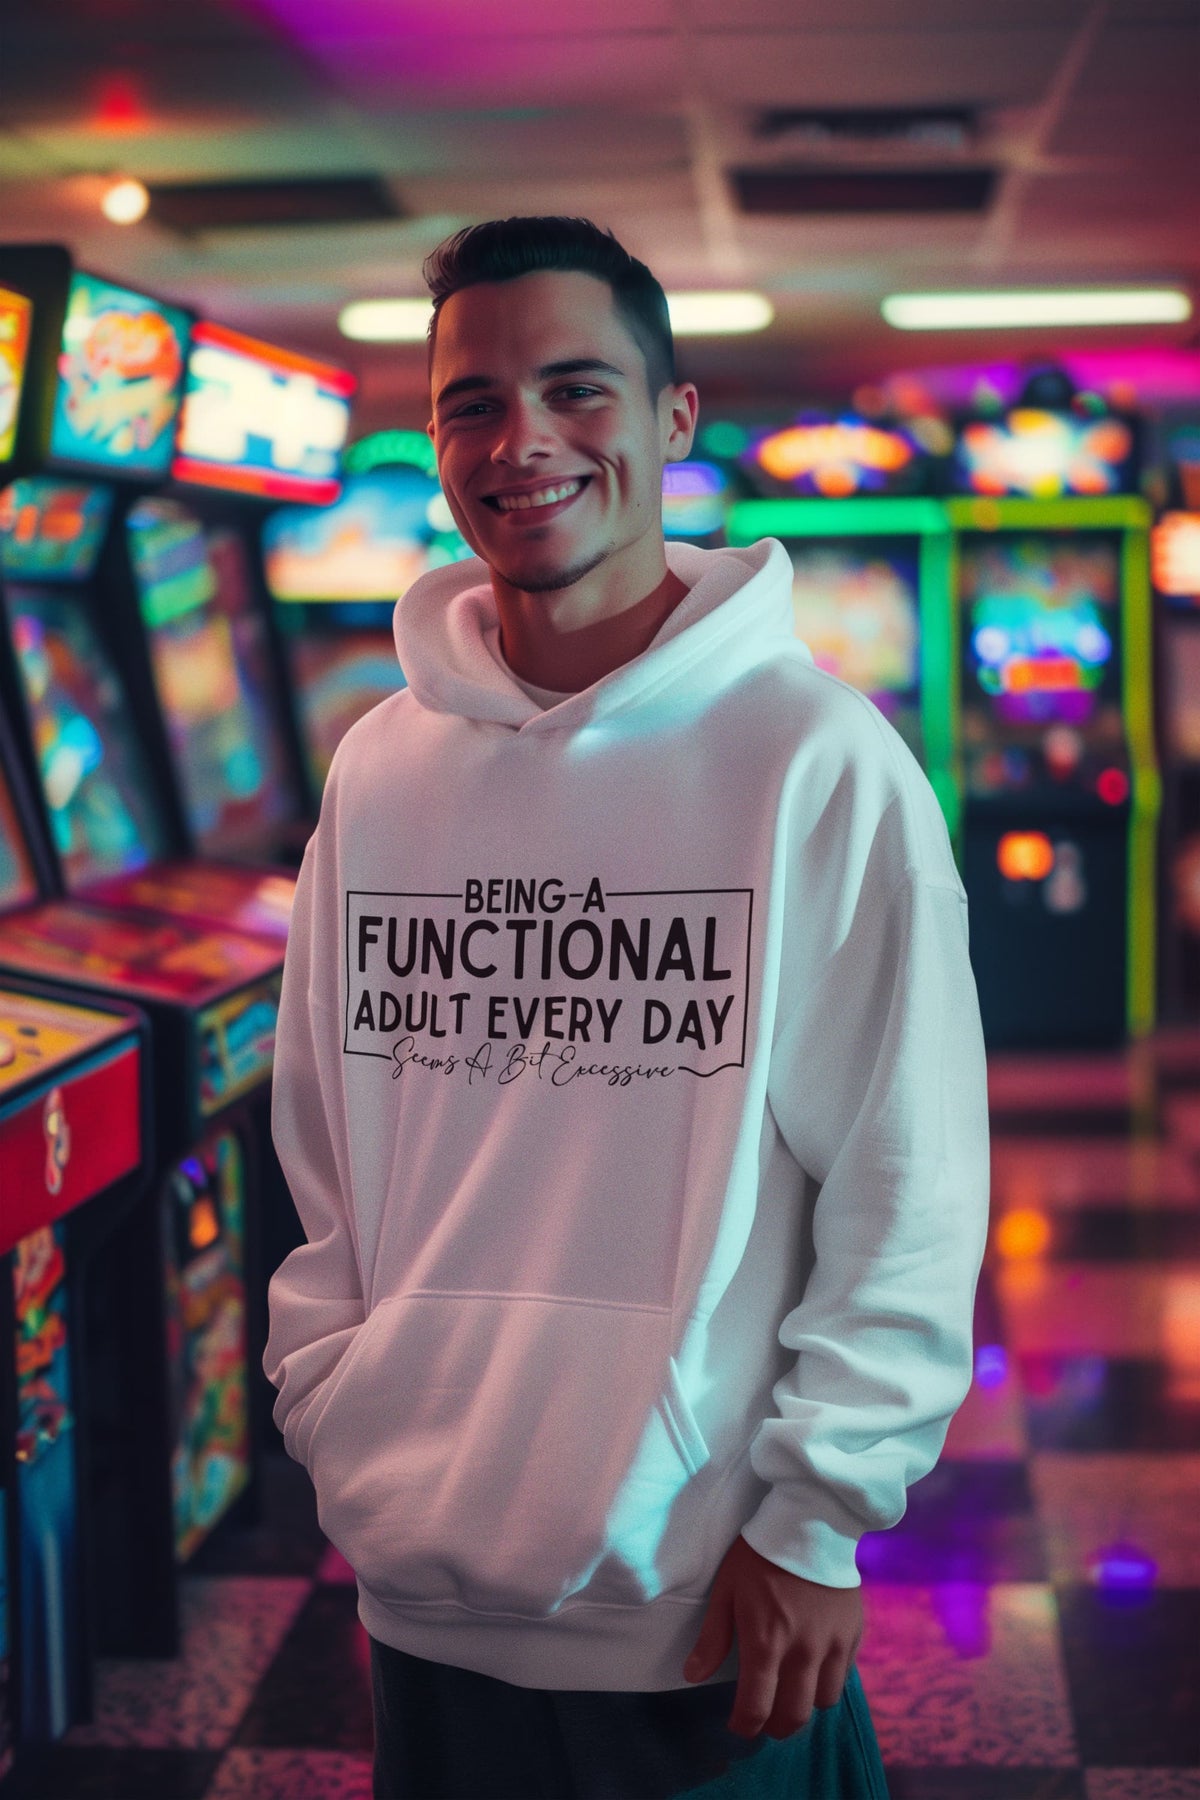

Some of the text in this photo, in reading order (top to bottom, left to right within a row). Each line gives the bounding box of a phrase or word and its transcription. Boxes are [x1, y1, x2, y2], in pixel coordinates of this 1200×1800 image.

[358, 915, 732, 982] FUNCTIONAL
[354, 989, 736, 1051] ADULT EVERY DAY
[391, 1036, 676, 1087] Seems A Bit Excessive
